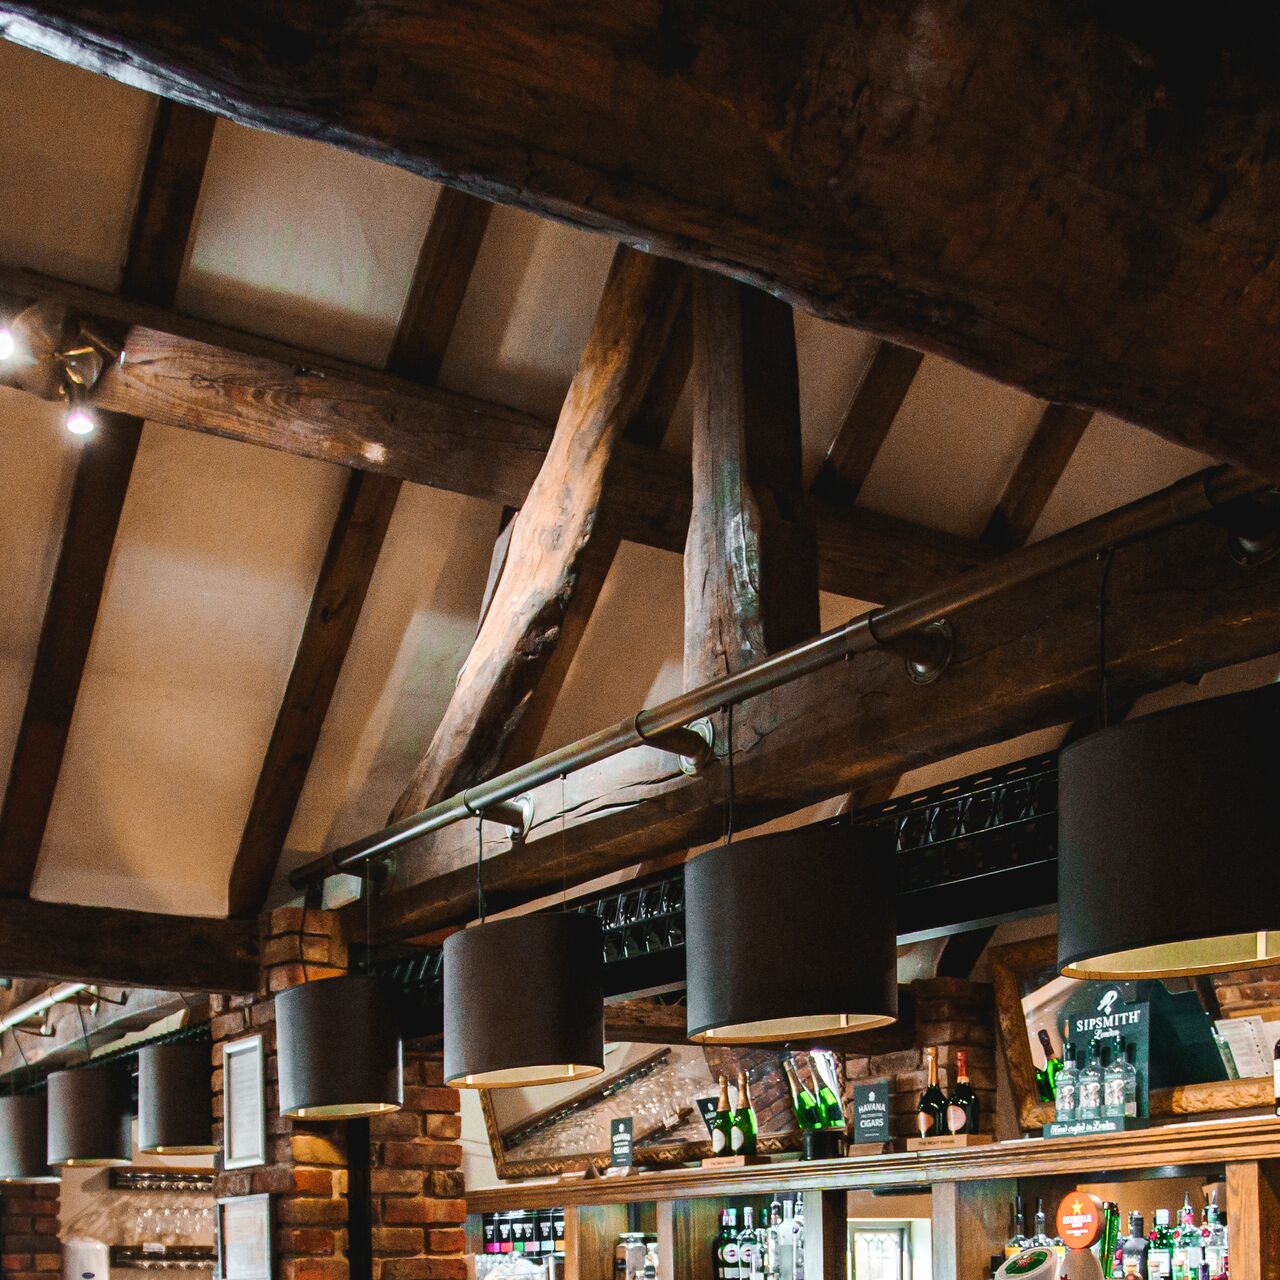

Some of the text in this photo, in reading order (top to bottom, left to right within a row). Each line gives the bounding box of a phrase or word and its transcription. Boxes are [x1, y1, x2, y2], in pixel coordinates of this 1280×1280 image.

[1076, 1010, 1140, 1032] SIPSMITH
[858, 1102, 887, 1114] HAVANA
[859, 1117, 885, 1129] CIGARS
